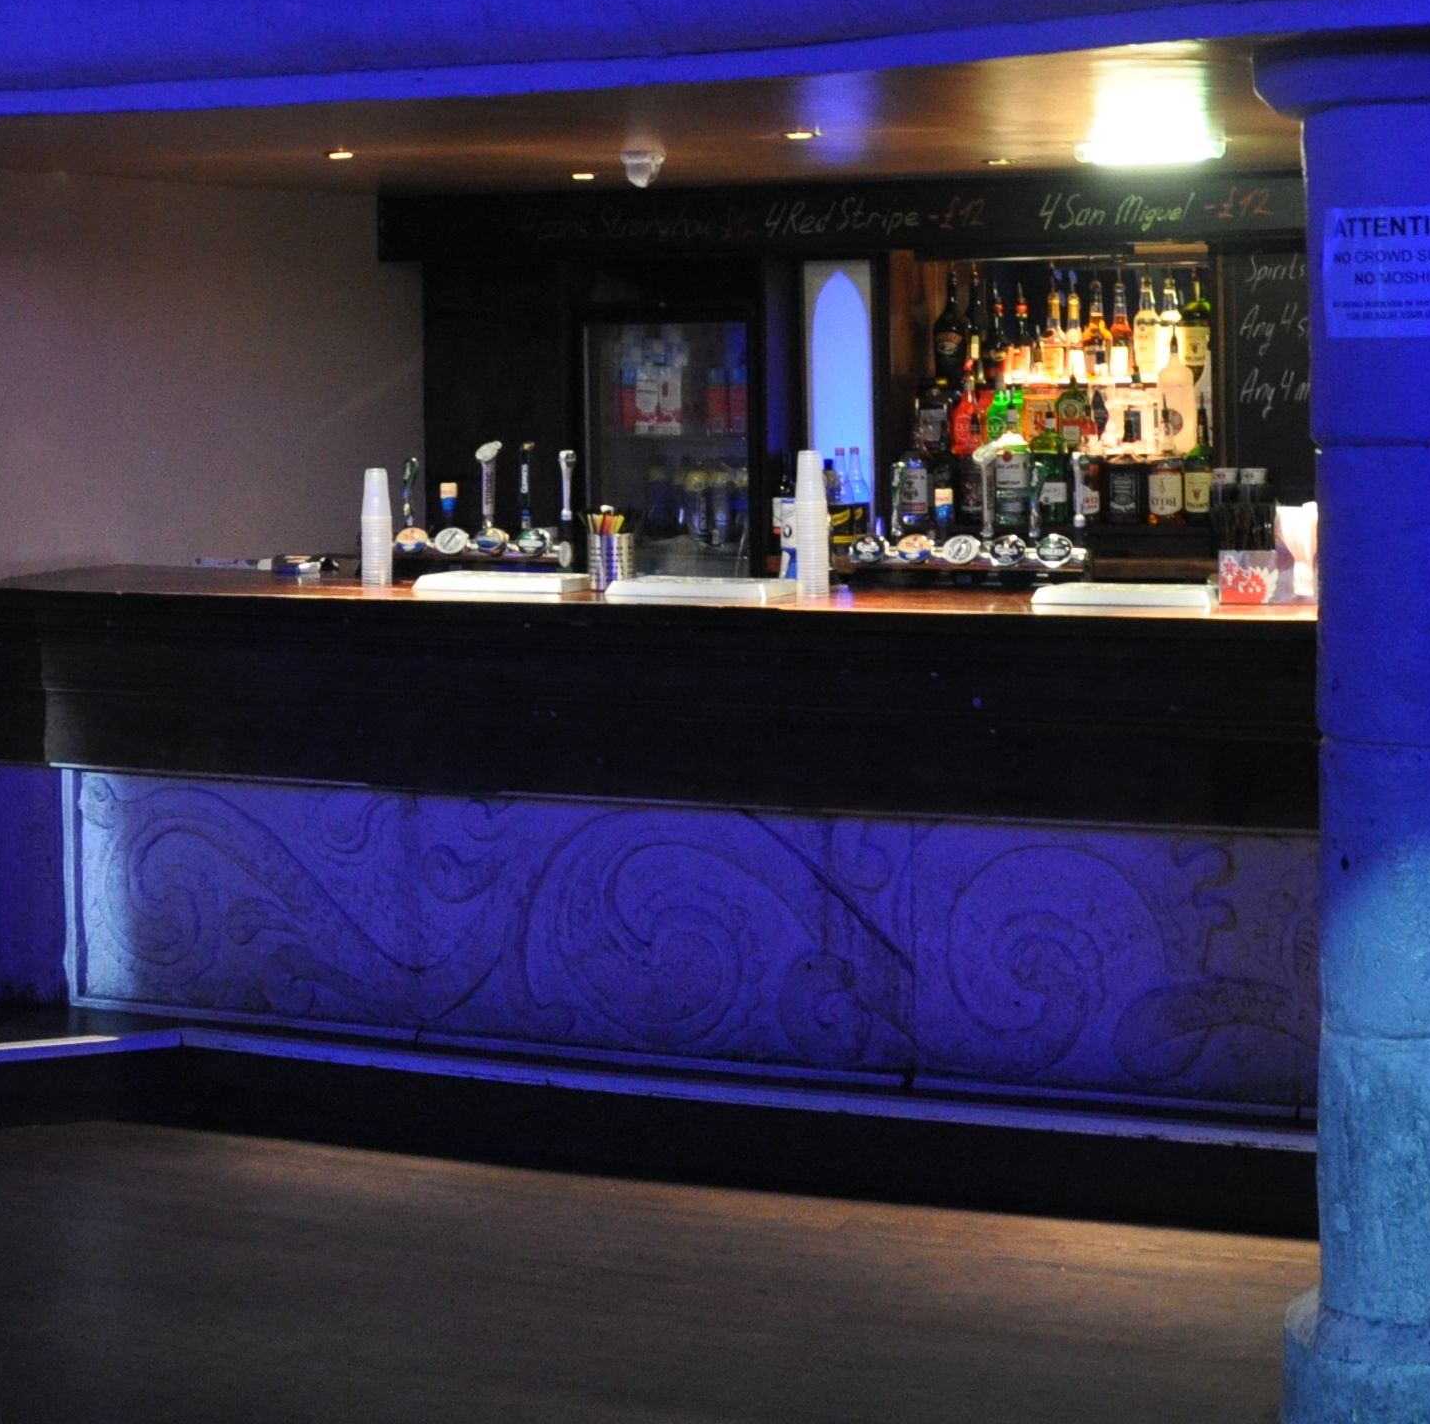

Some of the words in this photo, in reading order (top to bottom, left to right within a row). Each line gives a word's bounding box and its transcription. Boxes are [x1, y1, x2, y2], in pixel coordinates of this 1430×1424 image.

[764, 197, 787, 239] 4
[782, 198, 838, 236] Red
[835, 193, 921, 237] Stripe
[1039, 192, 1063, 232] 4
[1057, 192, 1107, 231] San
[1113, 190, 1196, 234] Miguel
[1244, 252, 1307, 293] Spirits
[1334, 251, 1352, 265] NO
[1355, 248, 1414, 265] CROWD
[1354, 272, 1375, 286] NO
[1239, 303, 1276, 358] Any
[1280, 301, 1299, 334] 4
[1239, 366, 1276, 420] Any
[1279, 368, 1296, 401] 4
